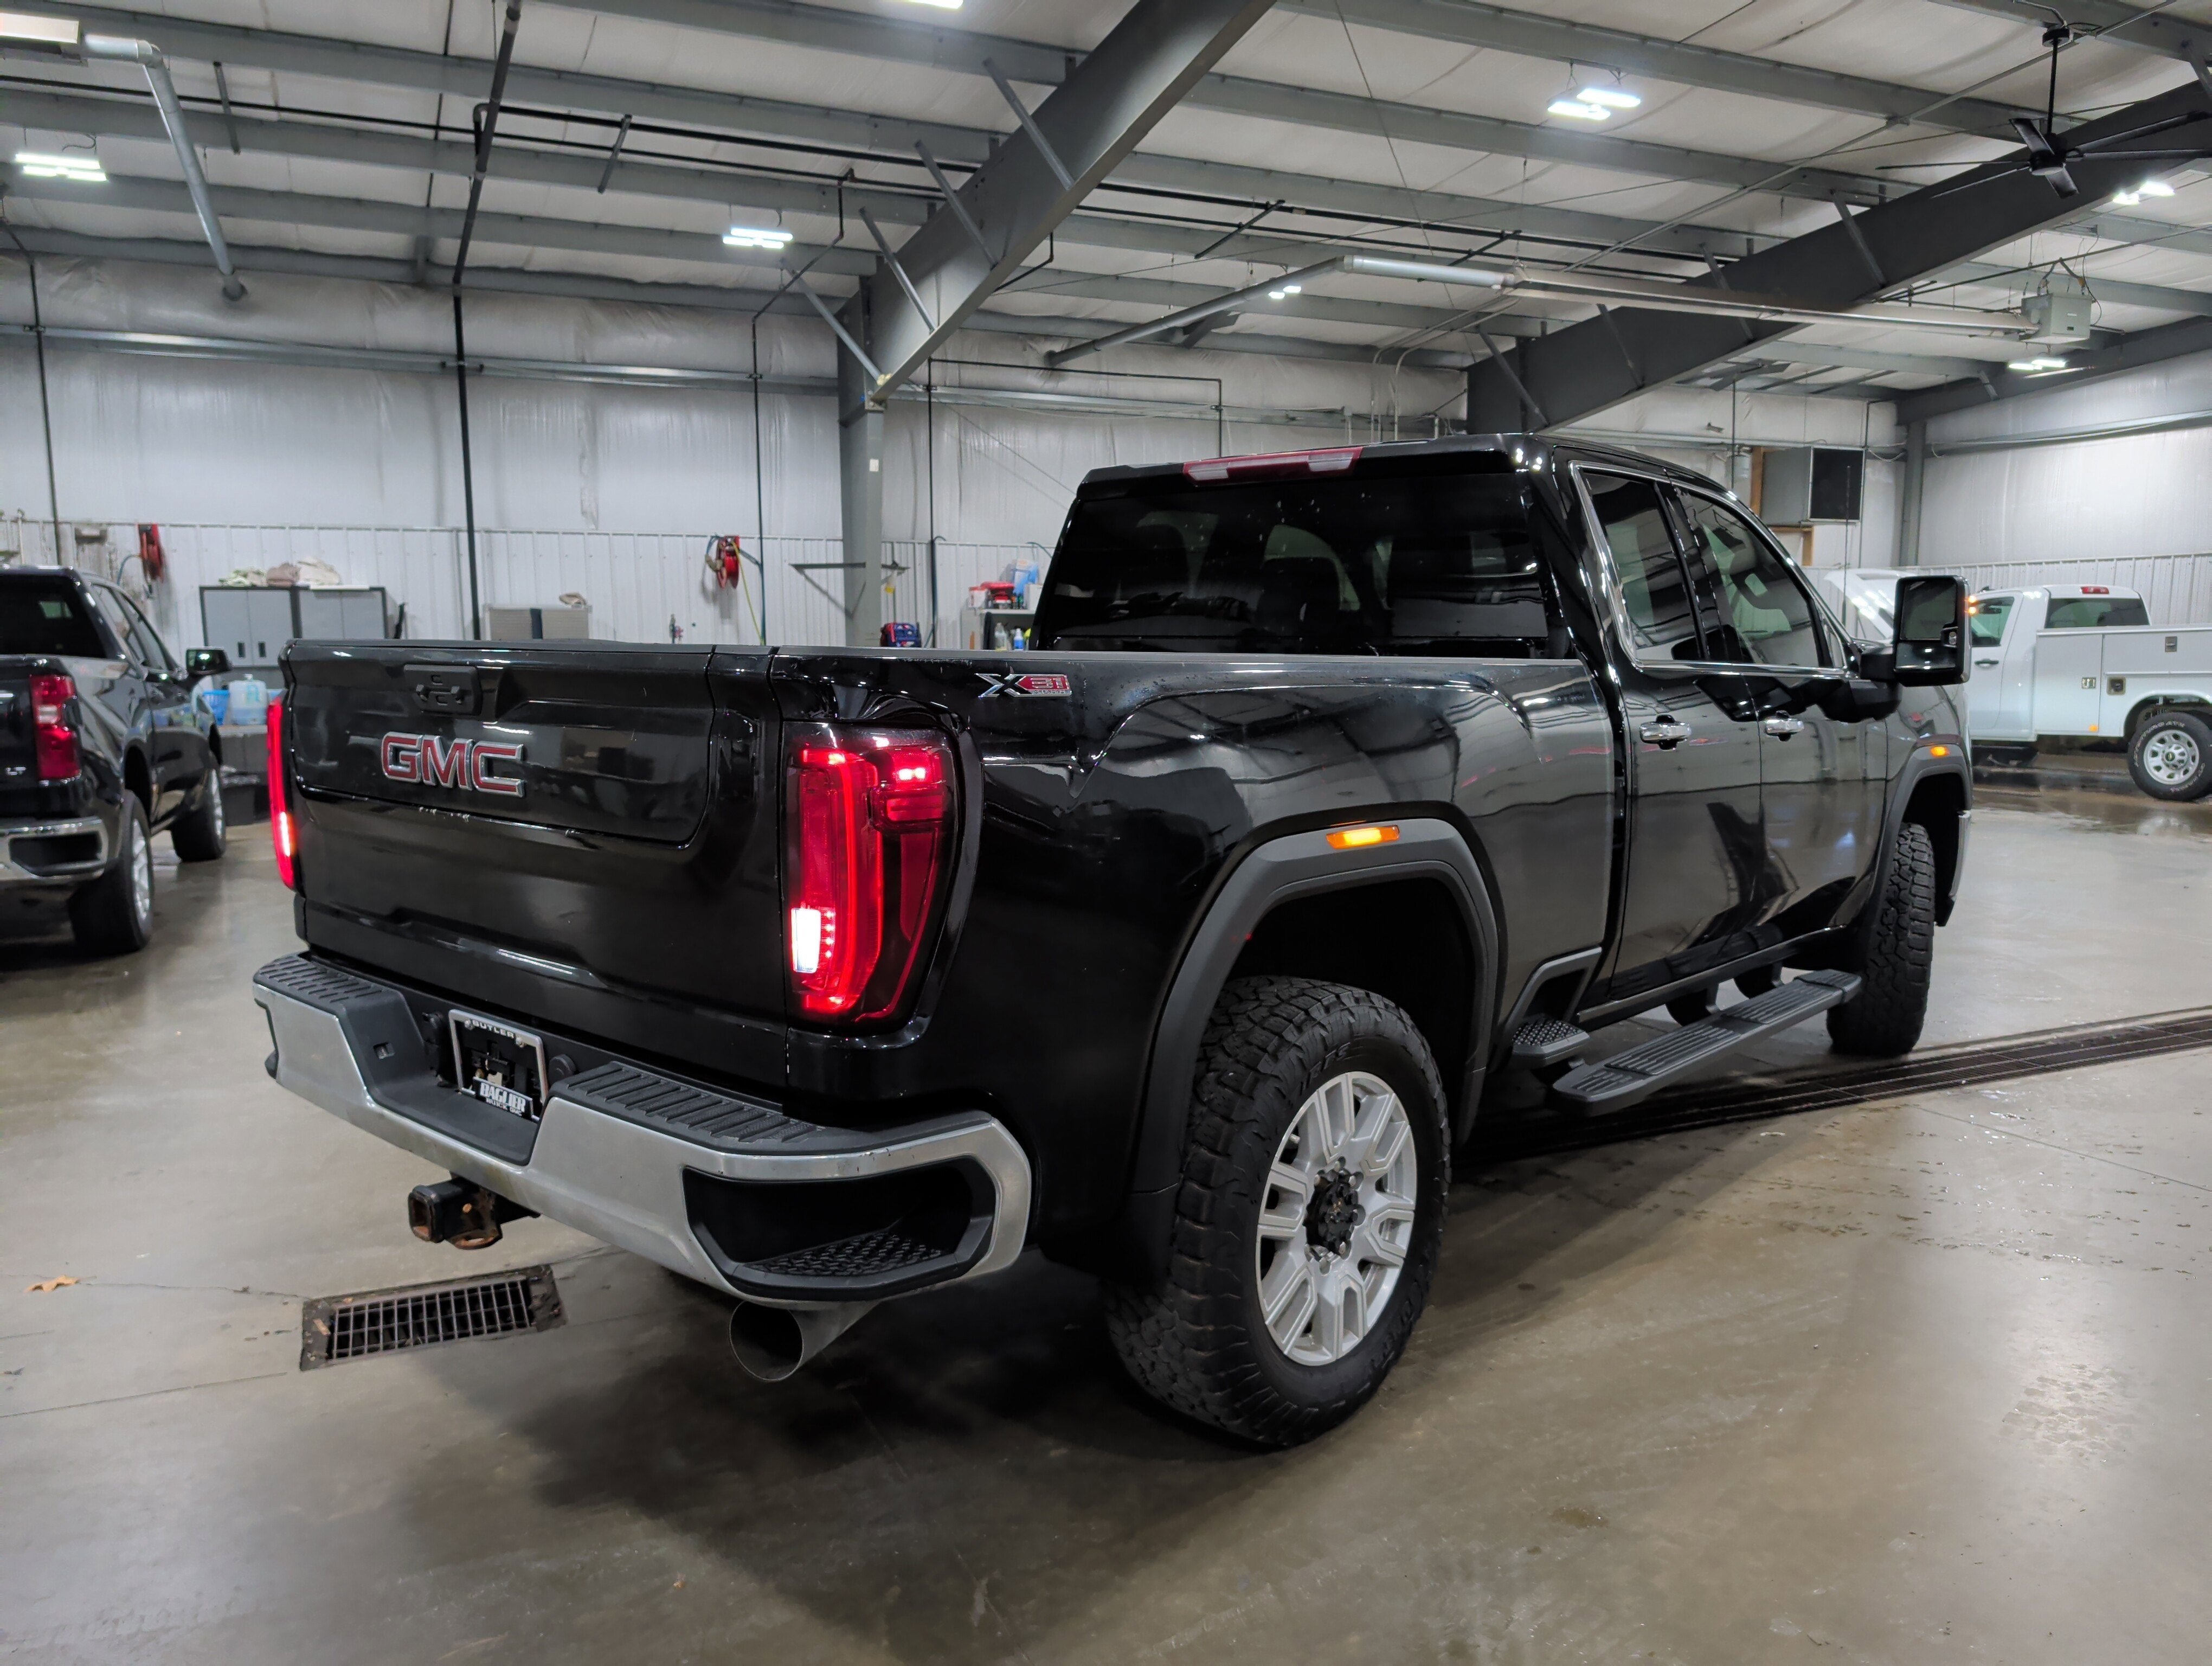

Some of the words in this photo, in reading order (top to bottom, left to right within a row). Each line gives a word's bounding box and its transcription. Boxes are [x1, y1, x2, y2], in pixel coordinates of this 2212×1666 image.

[381, 731, 524, 798] GMC
[472, 1020, 515, 1039] BUTLER
[480, 1082, 526, 1112] BAGLIER
